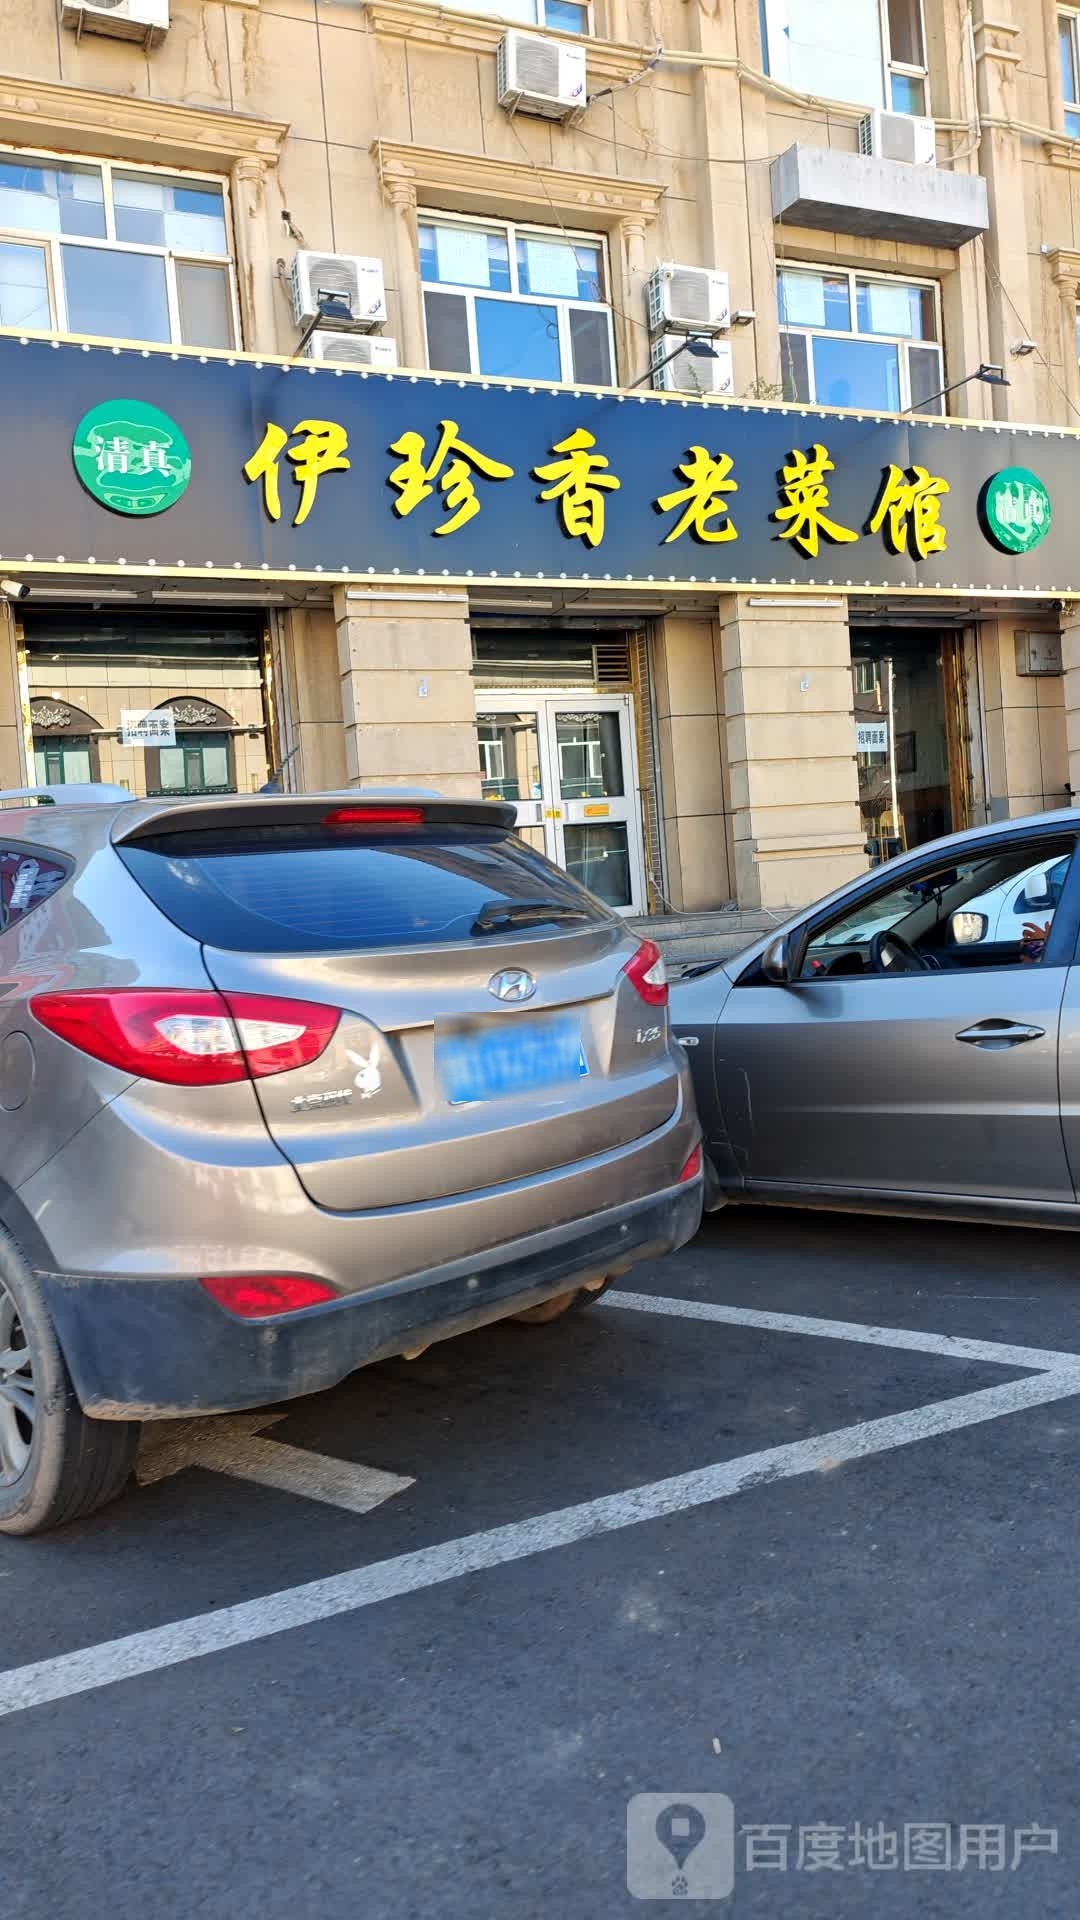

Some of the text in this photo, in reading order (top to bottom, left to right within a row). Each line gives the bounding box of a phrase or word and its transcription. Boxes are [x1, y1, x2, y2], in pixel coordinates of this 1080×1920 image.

[95, 436, 173, 478] 清真
[245, 420, 951, 557] 伊珍香老菜馆
